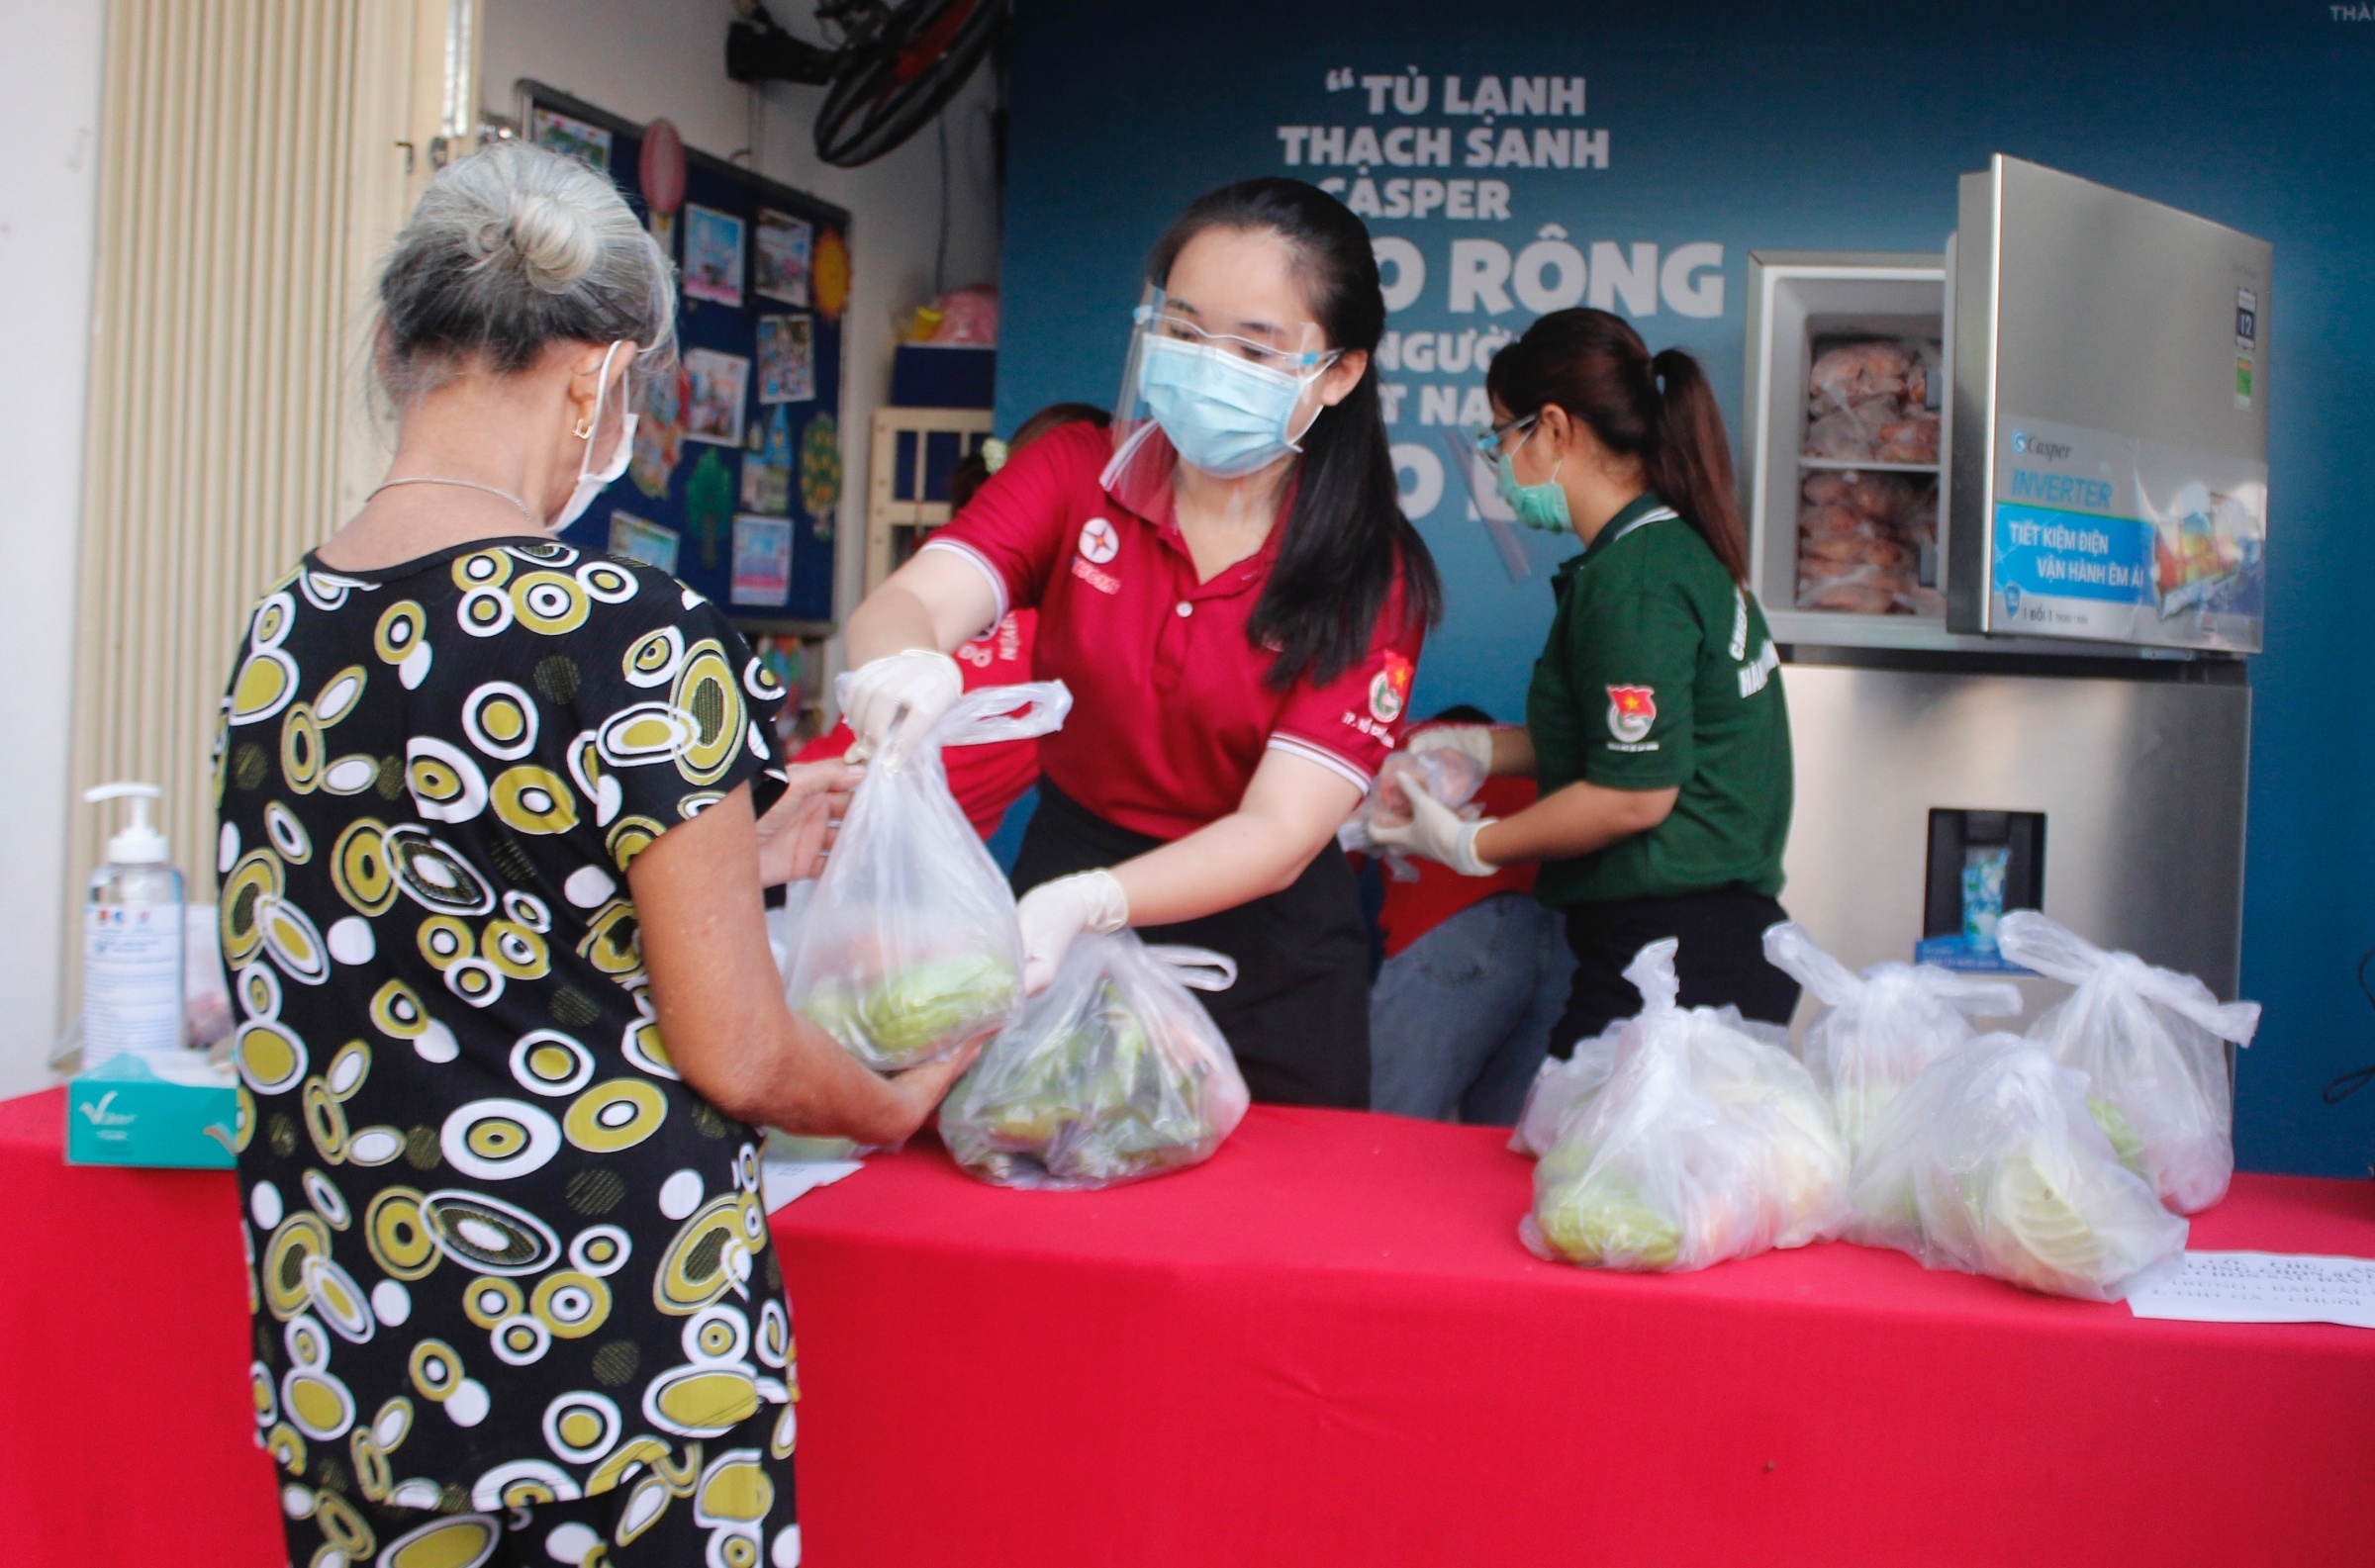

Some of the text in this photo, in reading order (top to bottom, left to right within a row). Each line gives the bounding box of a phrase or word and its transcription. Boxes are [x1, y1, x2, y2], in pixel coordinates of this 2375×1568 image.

[1444, 75, 1585, 124] LẠNH
[1278, 126, 1610, 174] THẠCH SANH
[2028, 435, 2073, 462] Casper
[2011, 468, 2114, 509] INVERTER
[2009, 518, 2109, 557] TIẾT KIỆM ĐIỆN
[2037, 553, 2143, 588] VẬN HÀNH ÊM ÁI
